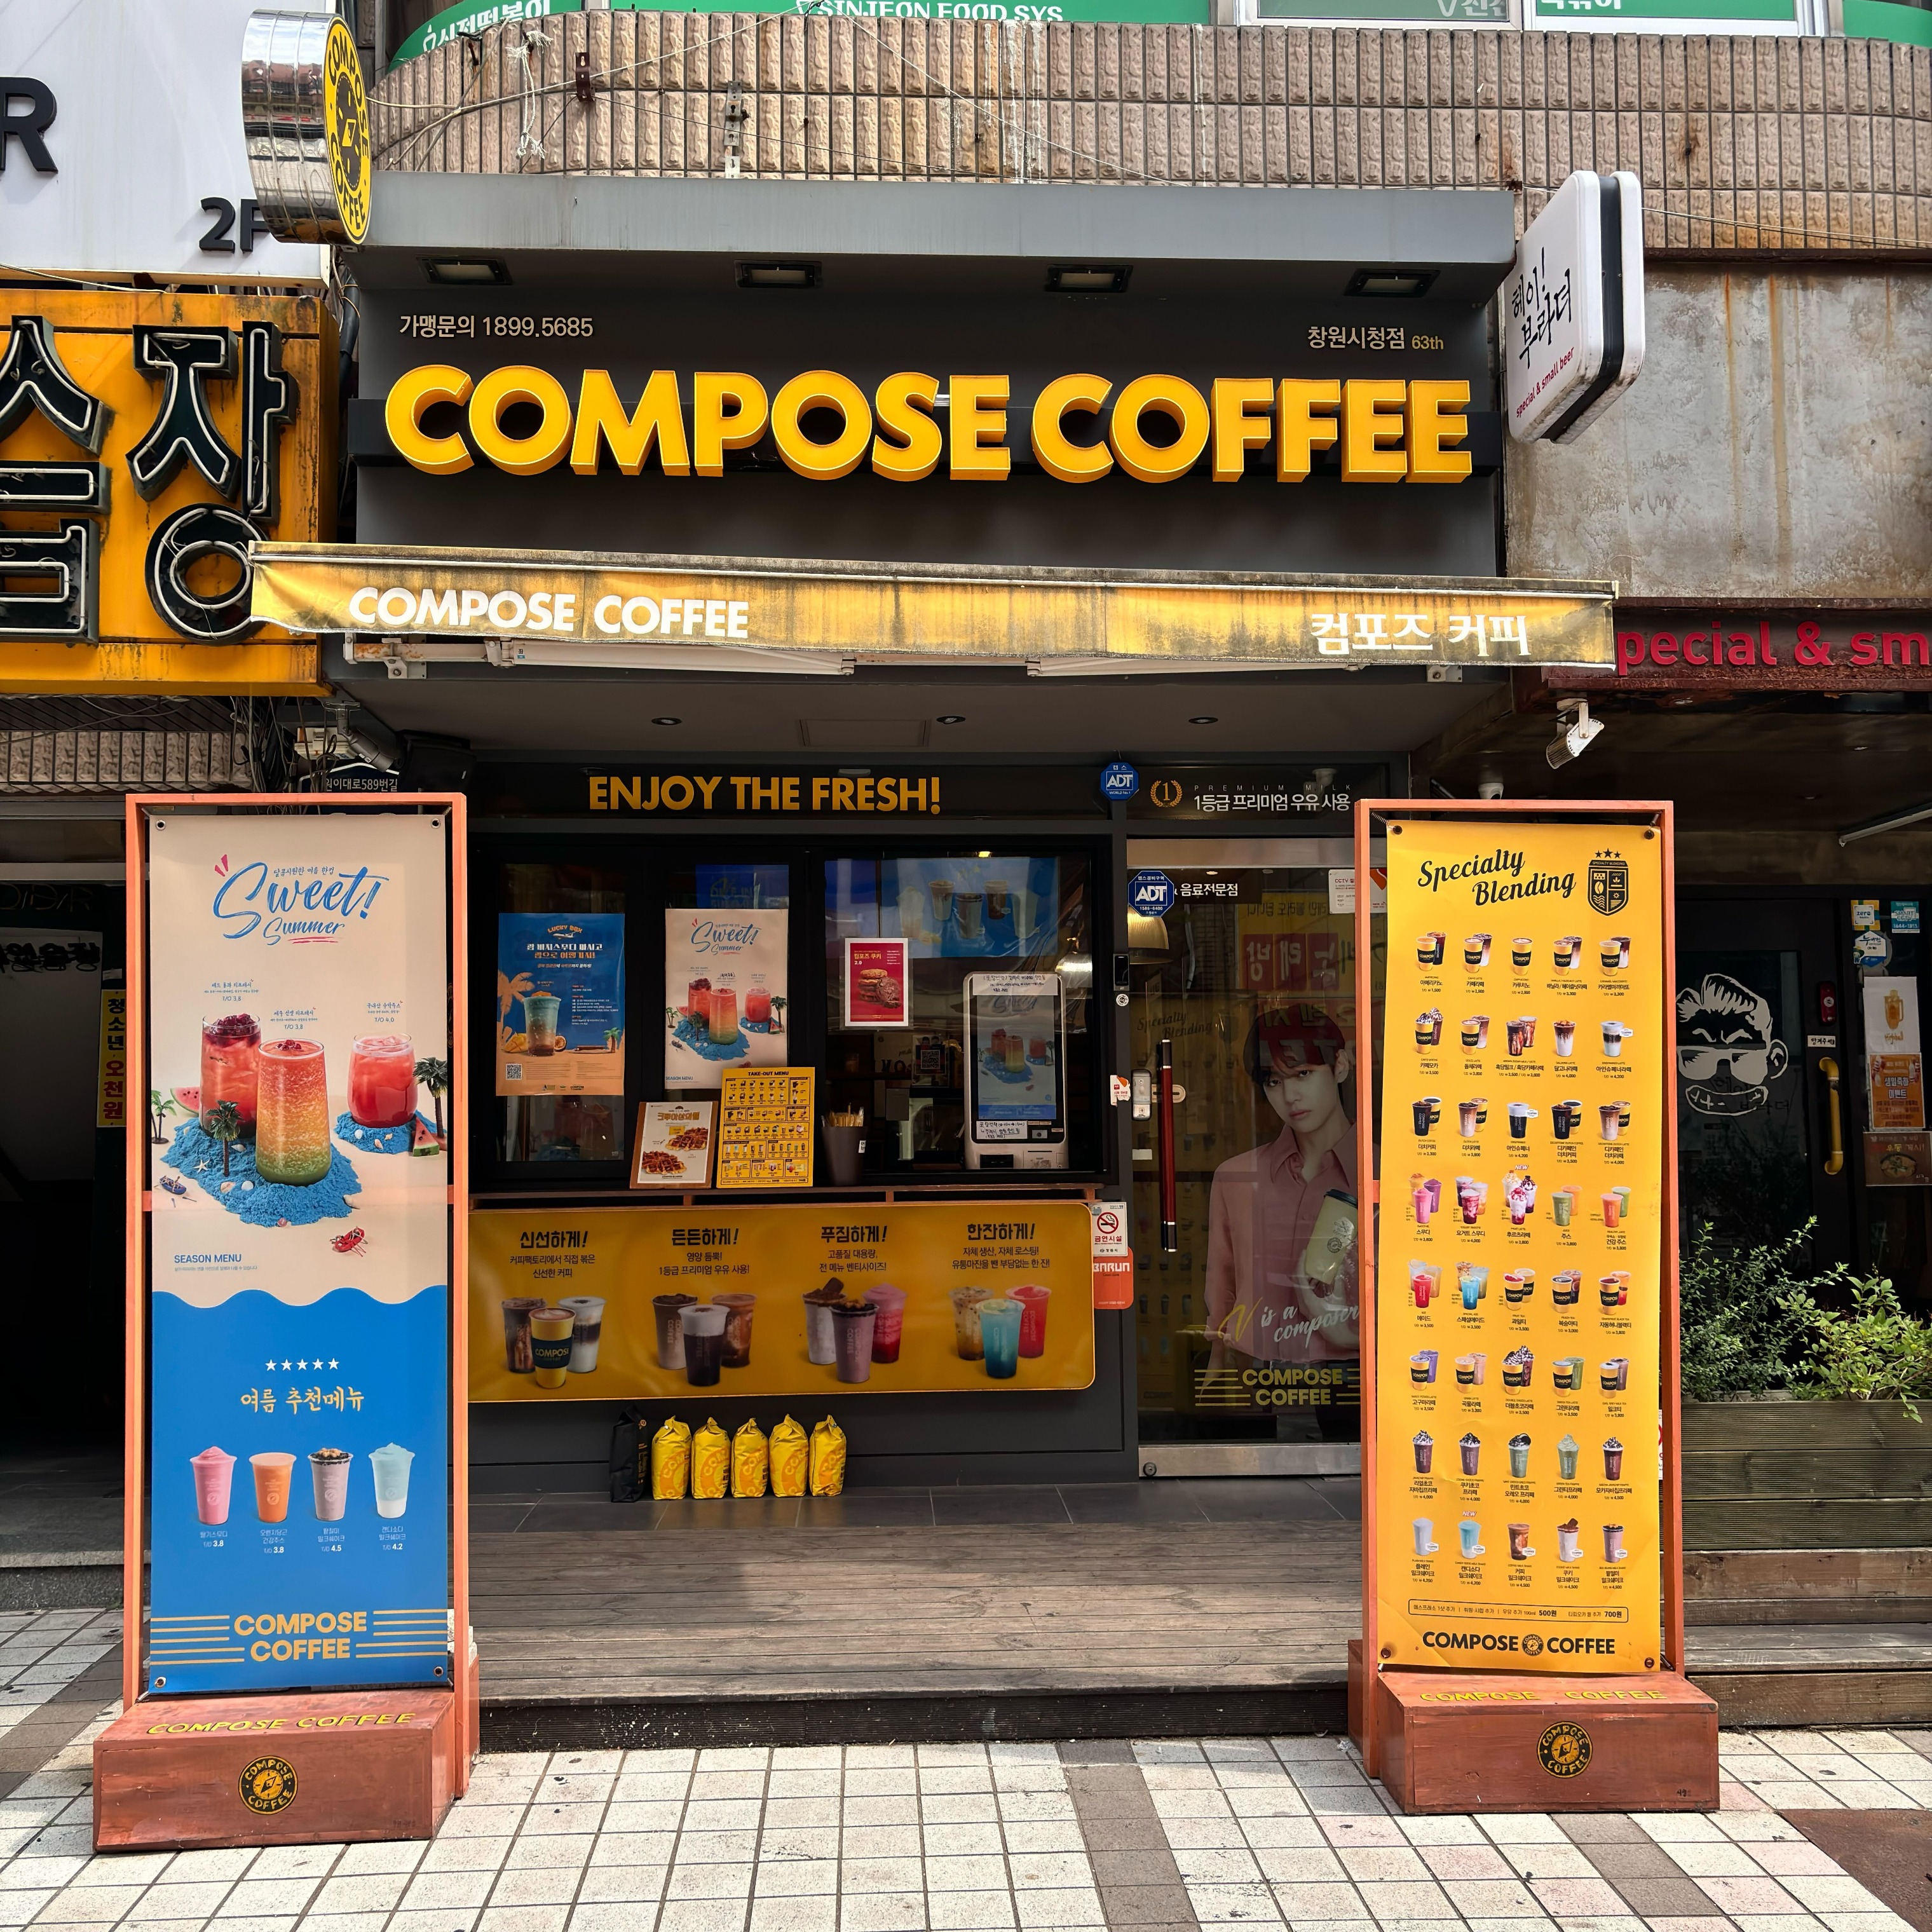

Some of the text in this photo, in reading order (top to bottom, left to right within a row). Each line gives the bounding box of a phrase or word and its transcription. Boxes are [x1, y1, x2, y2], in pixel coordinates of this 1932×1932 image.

[939, 3, 1007, 20] FOOD
[1017, 5, 1063, 22] SYS
[329, 29, 370, 160] COMPOSE
[330, 135, 367, 231] COFFEE
[199, 196, 271, 254] 2F
[399, 315, 594, 339] 가맹문의 1899.5685
[1307, 325, 1445, 351] 창원시청점 63th
[1516, 346, 1575, 418] special & small beer
[385, 364, 1473, 483] COMPOSE COFFEE
[349, 586, 749, 639] COMPOSE COFFEE
[1310, 611, 1532, 657] 컴포즈 커피
[1794, 620, 1832, 666] &
[1106, 774, 1133, 787] ADT
[1162, 782, 1171, 801] 1
[589, 775, 941, 815] ENJOY THE FRESH!
[1194, 793, 1351, 812] 1등급 프리미엄 우유 사용
[1418, 848, 1525, 892] Specialty
[1136, 885, 1167, 901] ADT
[1180, 883, 1239, 897] 음료전문점
[1472, 870, 1576, 906] Blending
[213, 862, 390, 939] Sweet!
[262, 917, 345, 946] Summer
[691, 922, 762, 953] Sweet!
[711, 944, 744, 956] Summer
[107, 998, 125, 1051] 청소년
[102, 1059, 125, 1120] 오천원
[1884, 1077, 1909, 1087] 생일축하
[1888, 1089, 1907, 1099] 이벤트
[520, 1230, 588, 1249] 신선하게!
[671, 1228, 739, 1246] 든든하게!
[820, 1225, 888, 1243] 푸짐하게!
[967, 1223, 1036, 1241] 한잔하게!
[174, 1254, 242, 1263] SEASON MENU
[510, 1254, 595, 1265] 커피팩토리에서 직접 볶은
[686, 1251, 722, 1262] 영양 듬뿍!
[827, 1249, 852, 1260] 고품질
[963, 1247, 979, 1256] 자체
[998, 1246, 1014, 1256] 자체
[1014, 1246, 1039, 1256] 로스팅!
[533, 1268, 573, 1279] 신선한 커피
[658, 1264, 750, 1276] 1등급 프리미엄 우유 사용!
[819, 1262, 887, 1272] 전 메뉴 벤티사이즈!
[952, 1260, 989, 1270] 유통마진을
[1000, 1259, 1029, 1269] 부담없는
[1031, 1259, 1040, 1269] 한
[1261, 1306, 1276, 1328] is
[1283, 1305, 1298, 1320] a
[1274, 1305, 1359, 1349] composer
[1242, 1368, 1343, 1385] COMPOSE
[240, 1385, 365, 1415] 여름 추천메뉴
[1255, 1389, 1331, 1406] COFFEE
[234, 1611, 367, 1636] COMPOSE
[250, 1638, 351, 1662] COFFEE
[1422, 1631, 1616, 1654] COMPOSE COFFEE
[1420, 1690, 1668, 1703] COMPOSE COFFEE
[147, 1713, 416, 1735] COMPOSE COFFEE
[1542, 1724, 1589, 1747] COMPOSE
[244, 1759, 294, 1781] COMPOSE
[1547, 1752, 1588, 1774] COFFEE
[247, 1788, 293, 1811] COFFEE
